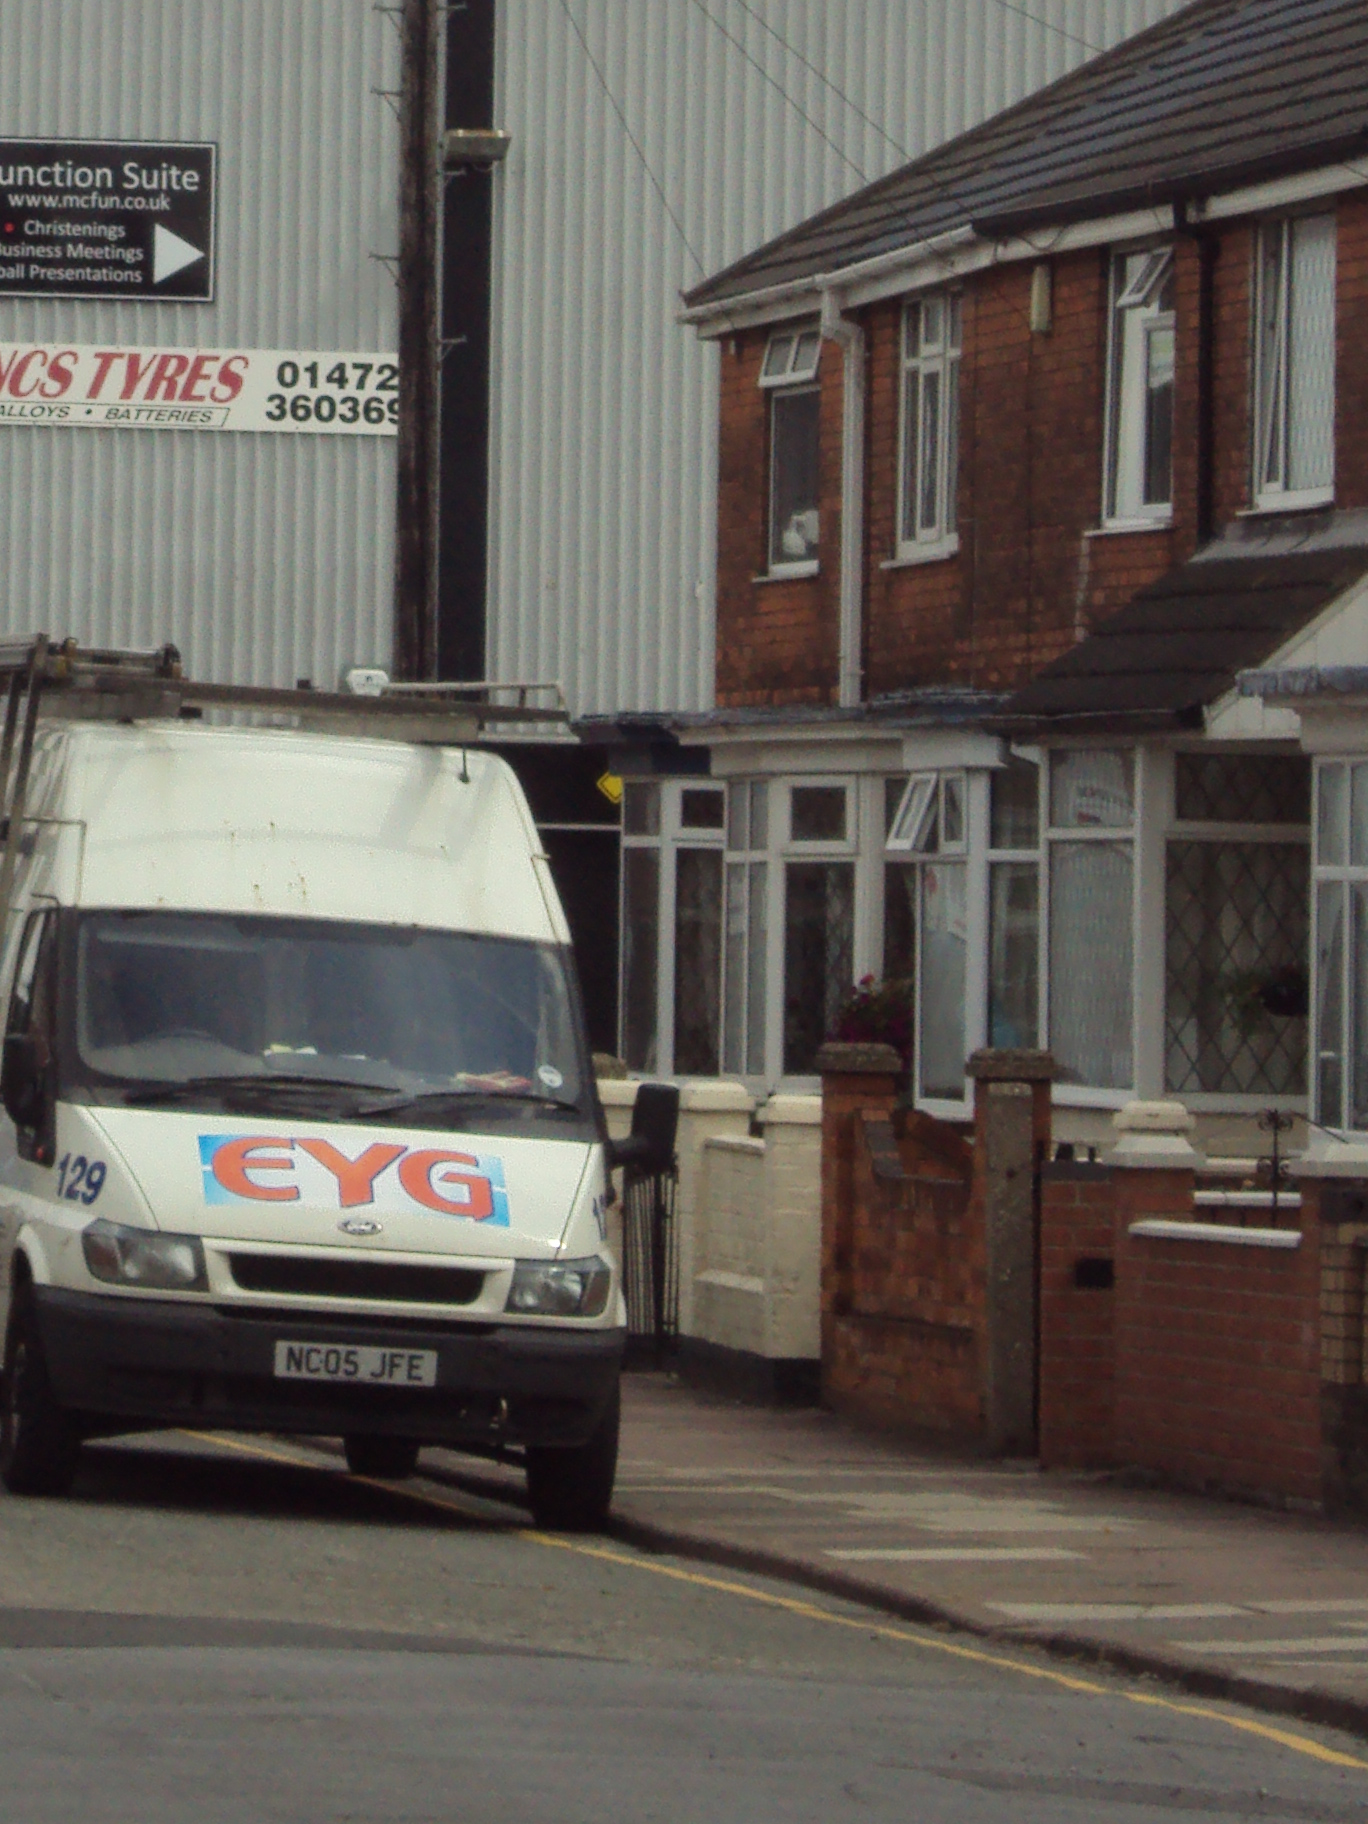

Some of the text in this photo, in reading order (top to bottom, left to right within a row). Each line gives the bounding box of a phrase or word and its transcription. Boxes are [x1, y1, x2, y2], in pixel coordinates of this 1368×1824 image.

[122, 161, 200, 191] Suite
[8, 191, 171, 210] www.mcfun.co.uk
[24, 219, 126, 240] Christenings
[66, 243, 144, 264] Meetings
[29, 264, 143, 283] Presentations
[86, 352, 250, 404] TYRES
[277, 360, 399, 391] 01472
[104, 407, 214, 423] BATTERIES
[56, 1151, 107, 1206] 129
[211, 1136, 495, 1222] EYG
[286, 1344, 425, 1381] NC05 JFE
